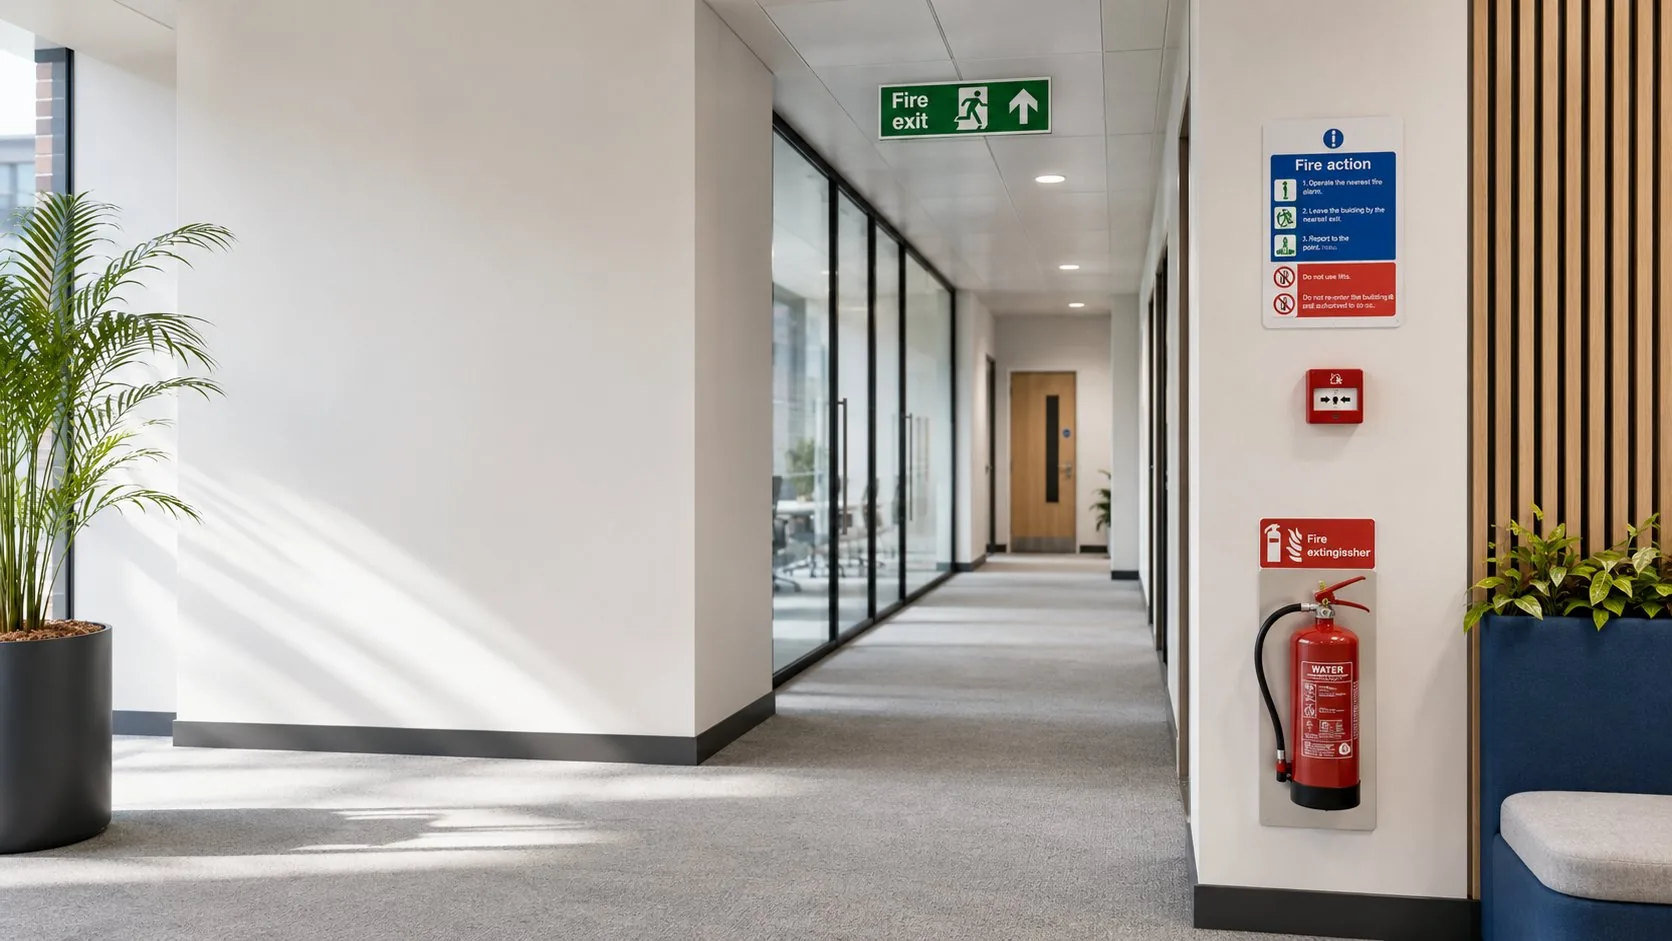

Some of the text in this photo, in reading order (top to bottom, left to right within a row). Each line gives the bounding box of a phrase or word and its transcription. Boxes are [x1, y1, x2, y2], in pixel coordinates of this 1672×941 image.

[892, 91, 929, 109] Fire
[892, 112, 929, 130] exit
[1295, 158, 1371, 171] Fire action
[1308, 179, 1334, 188] Operate
[1365, 206, 1374, 214] by
[1307, 534, 1328, 544] Fire
[1307, 548, 1371, 559] extingissher
[1311, 665, 1344, 674] WATER
